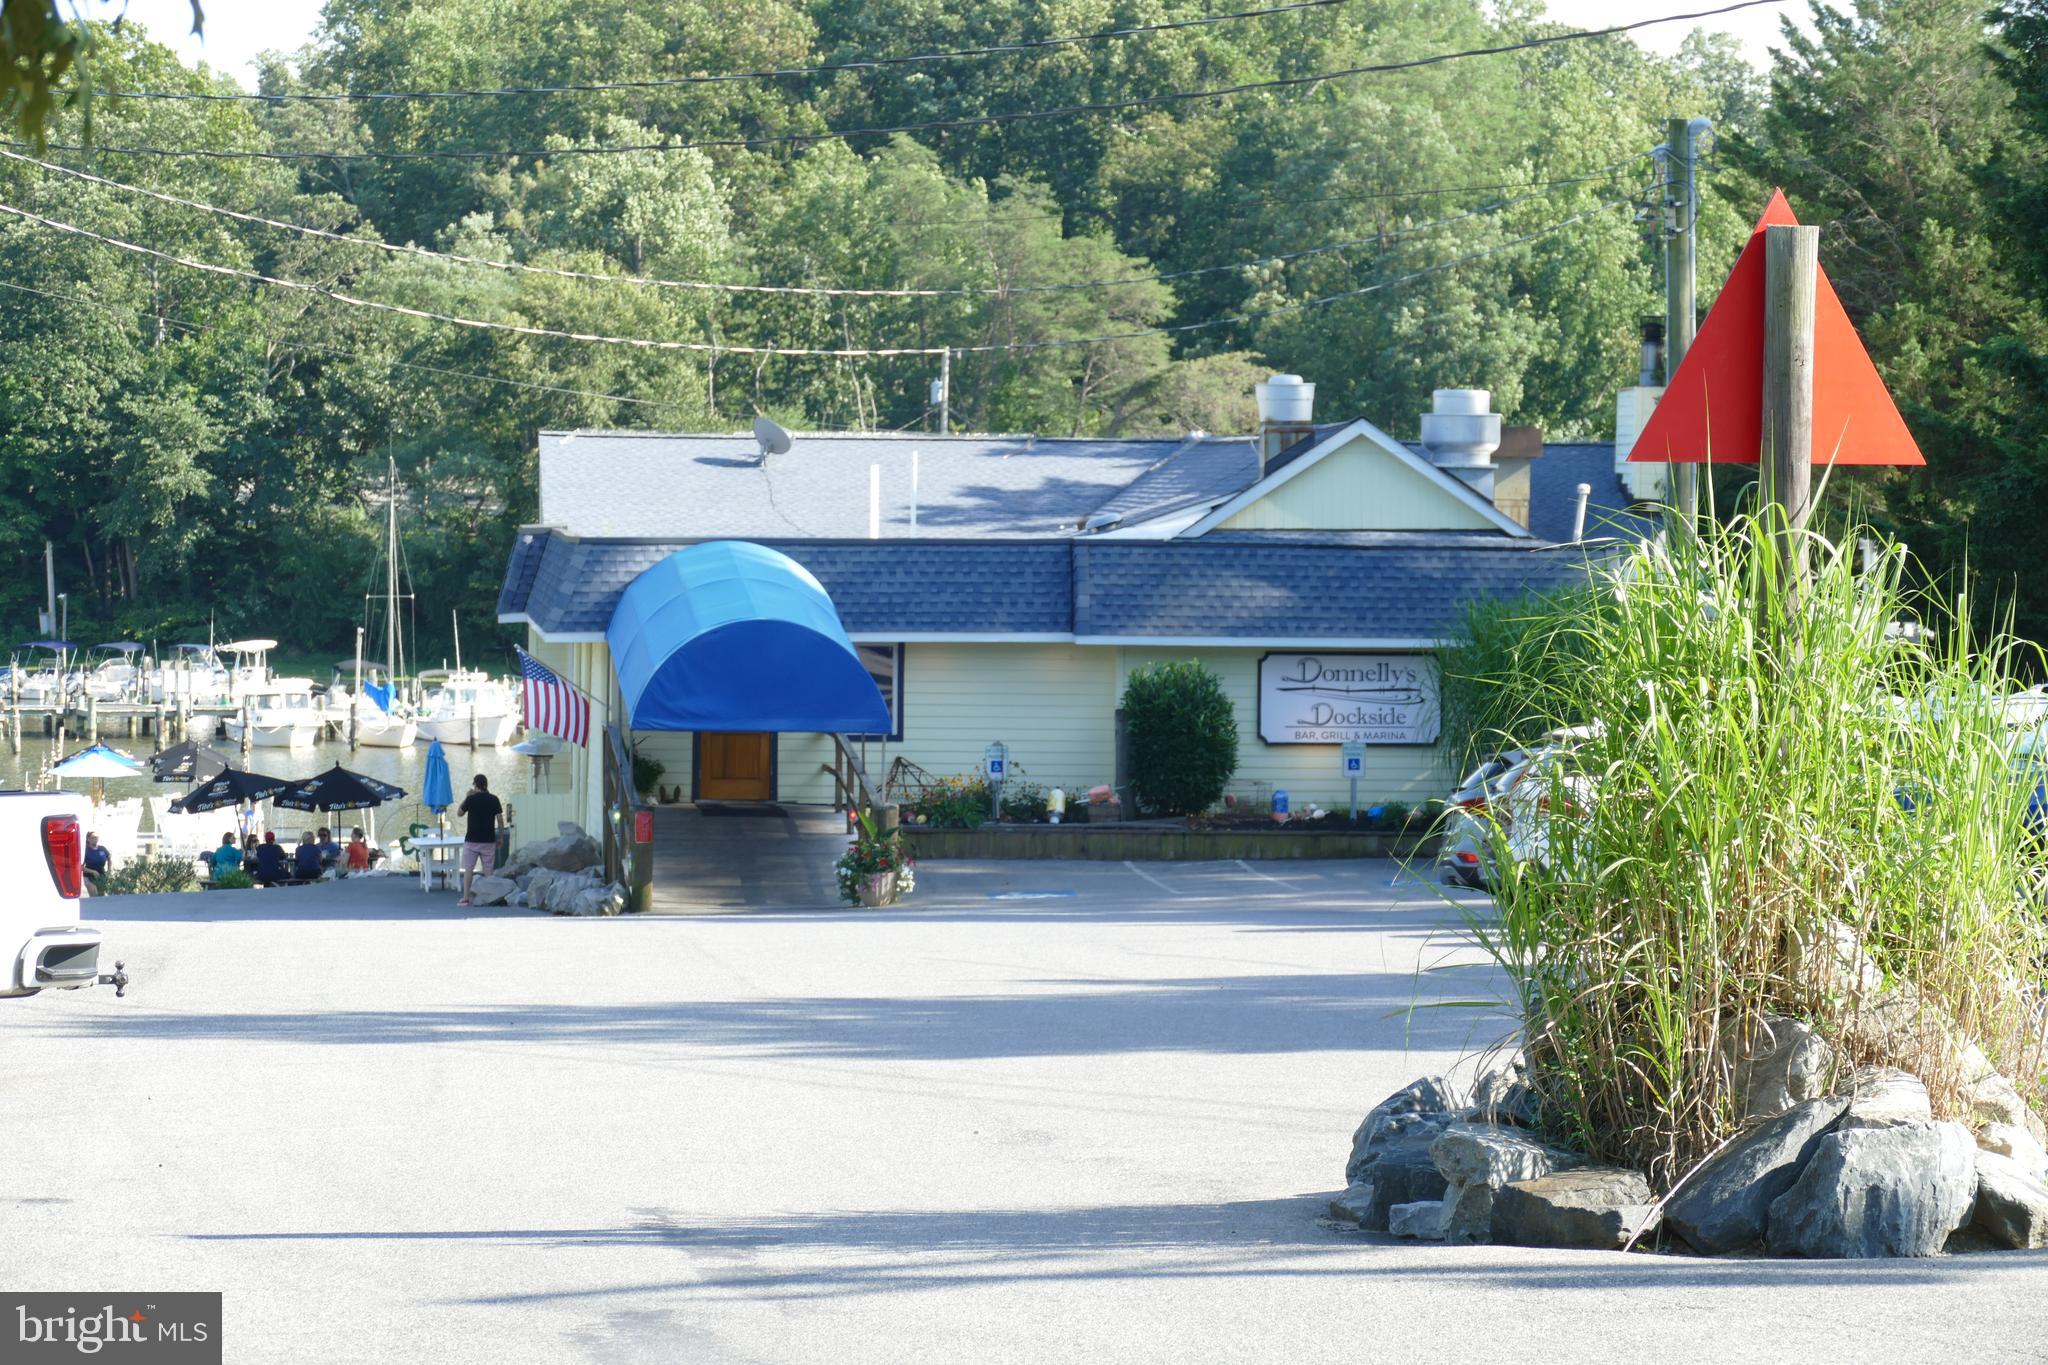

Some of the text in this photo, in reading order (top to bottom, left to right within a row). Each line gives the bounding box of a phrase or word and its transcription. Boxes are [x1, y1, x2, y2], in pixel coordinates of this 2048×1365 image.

[1281, 657, 1417, 685] Donnelly's
[1297, 702, 1407, 726] Dockside
[1294, 731, 1407, 741] BAR, GRILL & MARINA
